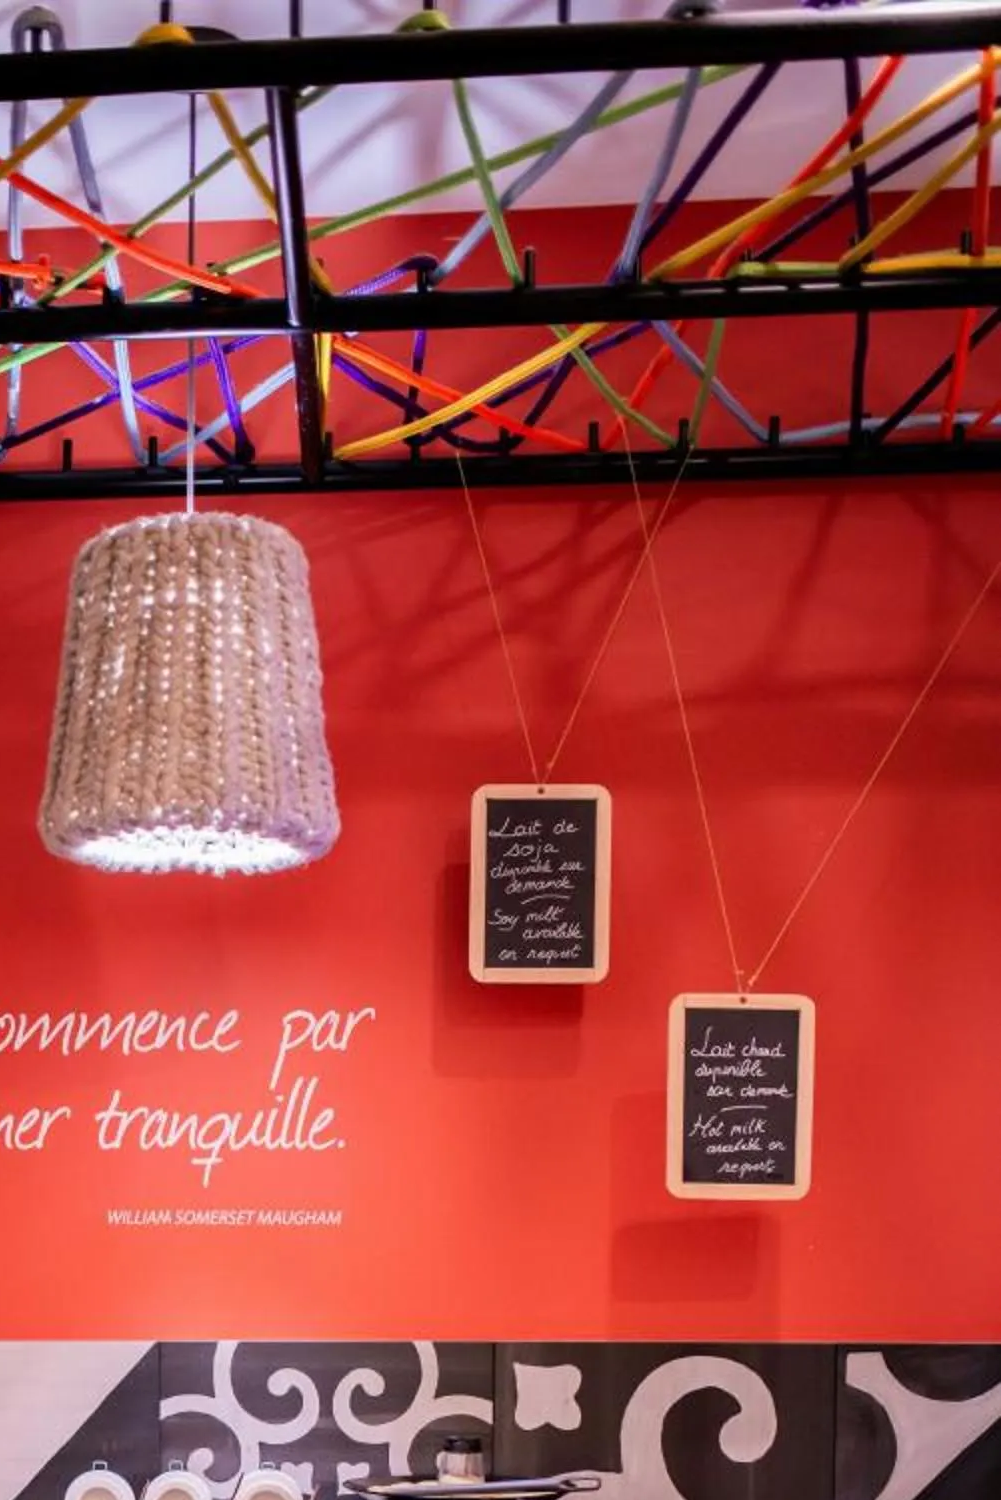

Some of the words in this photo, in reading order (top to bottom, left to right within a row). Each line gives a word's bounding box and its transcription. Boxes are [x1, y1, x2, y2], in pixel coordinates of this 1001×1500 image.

[488, 817, 543, 837] Lait
[553, 819, 579, 835] de
[503, 839, 559, 862] soja
[504, 879, 575, 894] demande
[488, 907, 519, 929] Soy
[498, 948, 517, 961] on
[270, 1007, 376, 1091] par
[690, 1026, 735, 1057] Lait
[95, 1076, 346, 1188] tranquille.
[689, 1113, 723, 1138] Hot
[730, 1117, 767, 1136] milk
[768, 1140, 787, 1152] on
[107, 1209, 172, 1225] WILLIAM
[174, 1209, 253, 1225] SOMERSET
[256, 1209, 343, 1225] MAUGHAM
